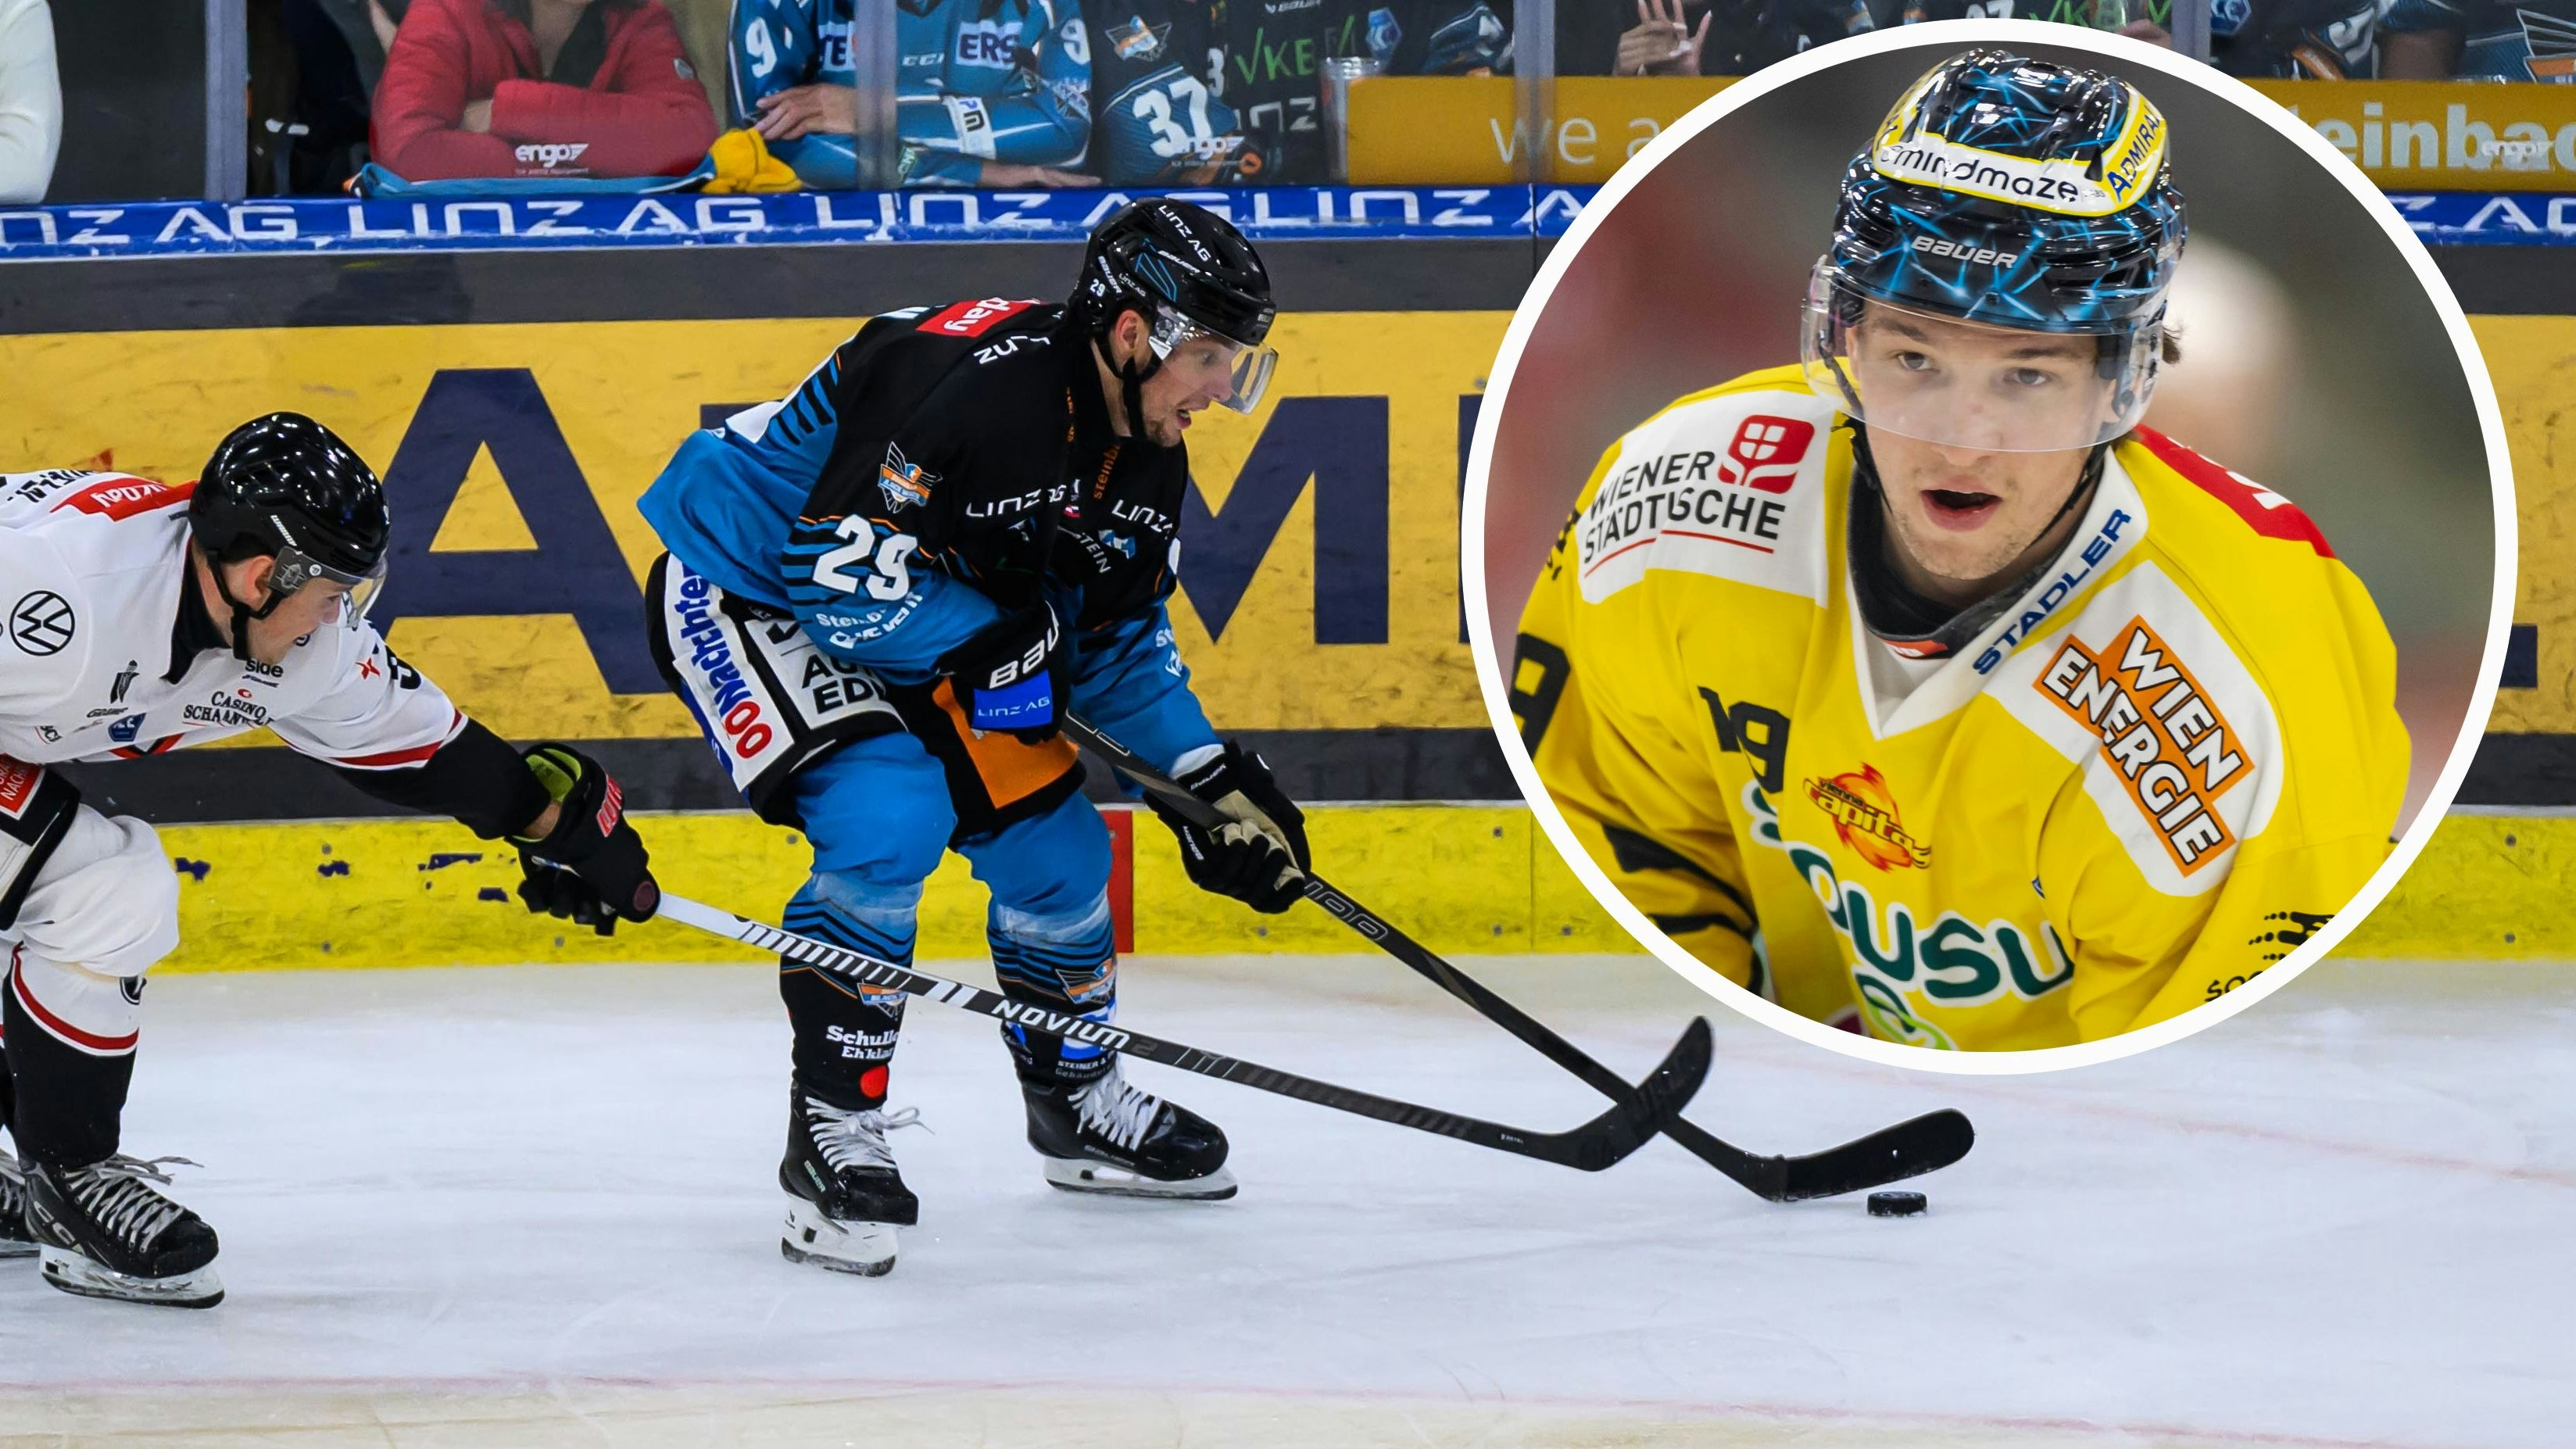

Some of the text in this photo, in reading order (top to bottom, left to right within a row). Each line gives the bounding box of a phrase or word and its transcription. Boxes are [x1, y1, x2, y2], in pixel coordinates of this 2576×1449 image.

[1132, 76, 1211, 157] 37
[1491, 115, 1597, 163] we
[2288, 102, 2576, 172] einba
[515, 144, 571, 168] engo
[156, 205, 299, 242] AG
[616, 197, 767, 233] AG
[1911, 234, 2019, 269] BAUER
[1089, 278, 1107, 297] 29
[1590, 451, 1716, 521] WIENER
[812, 513, 918, 601] 29
[1972, 508, 2132, 676] STADLER
[211, 691, 267, 720] CASINO
[1025, 696, 1050, 711] AG
[2119, 625, 2244, 792] WIEN
[1697, 685, 1791, 795] 19
[2041, 643, 2225, 865] ENERGIE
[991, 999, 1131, 1050] NOVIUM
